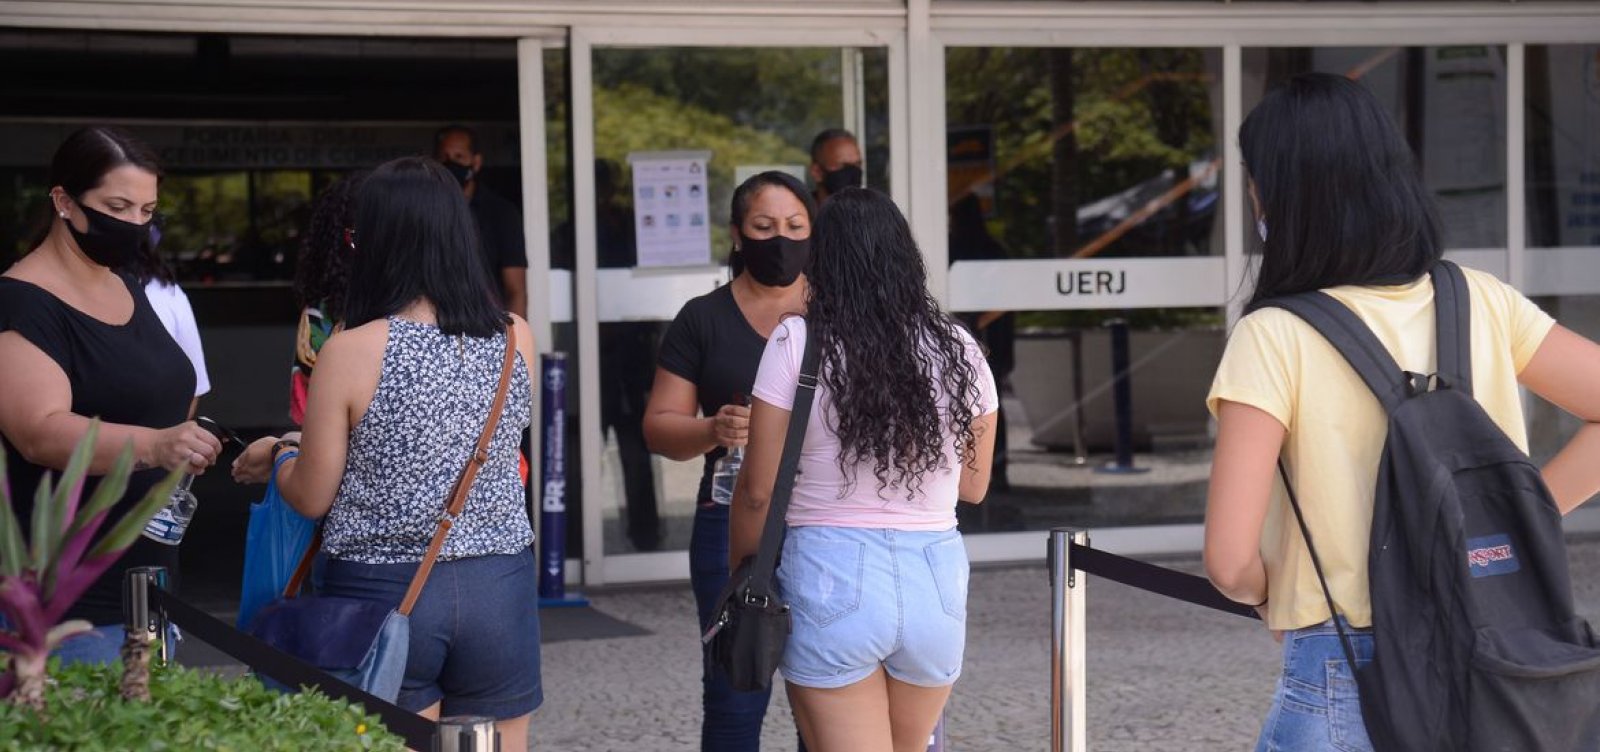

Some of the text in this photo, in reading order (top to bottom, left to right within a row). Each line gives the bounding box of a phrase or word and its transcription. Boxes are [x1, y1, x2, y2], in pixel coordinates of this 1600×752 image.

[183, 127, 292, 143] PORTARIA
[161, 147, 283, 163] CEBIMENTO
[1056, 271, 1126, 294] UERJ
[1468, 545, 1513, 567] NSPORT
